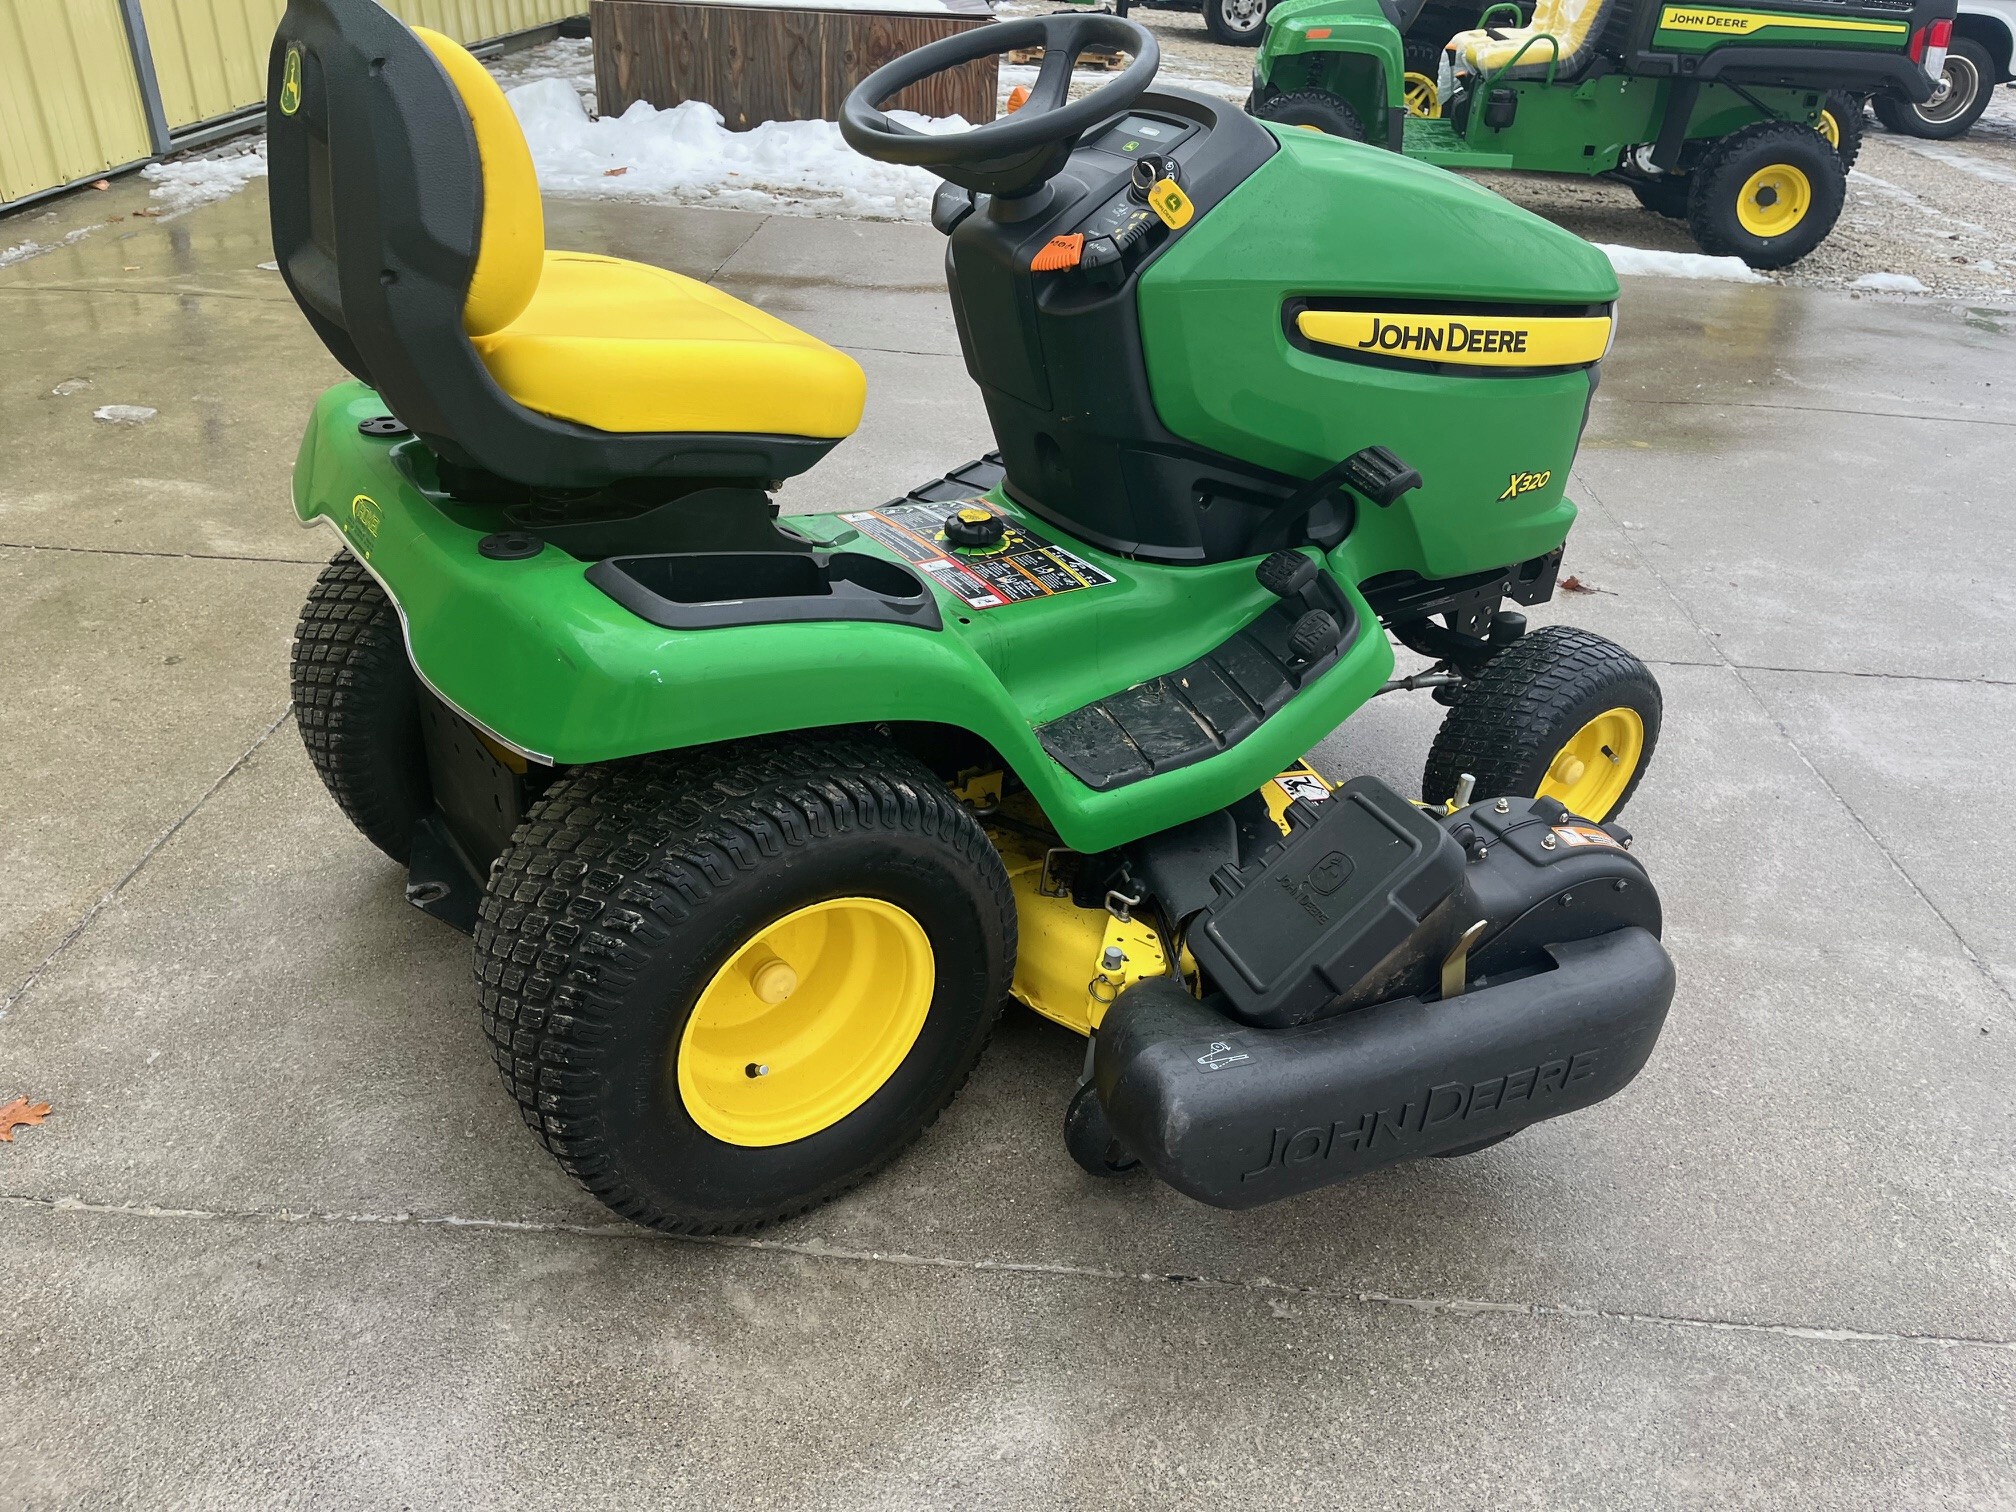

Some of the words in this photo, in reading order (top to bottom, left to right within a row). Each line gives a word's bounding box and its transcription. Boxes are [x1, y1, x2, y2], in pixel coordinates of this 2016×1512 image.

[1670, 13, 1704, 25] JOHN
[1706, 15, 1749, 28] DEERE
[1358, 318, 1444, 351] JOHN
[1447, 322, 1528, 353] DEERE
[1496, 469, 1551, 503] X320
[1275, 874, 1303, 900] JOHN
[1298, 894, 1330, 926] DEERE
[1240, 1103, 1415, 1183] JOHN
[1418, 1049, 1600, 1133] DEERE
